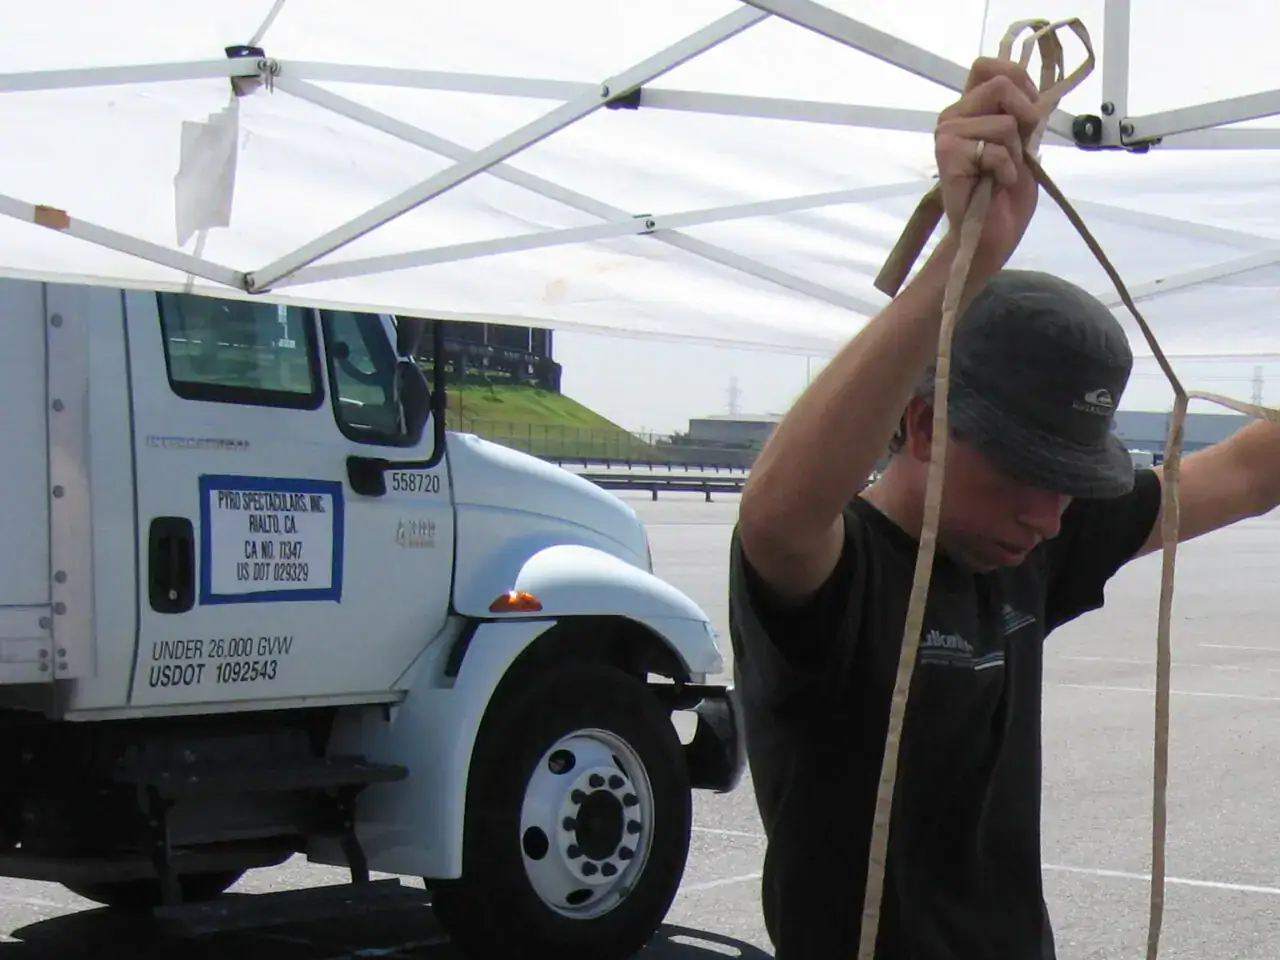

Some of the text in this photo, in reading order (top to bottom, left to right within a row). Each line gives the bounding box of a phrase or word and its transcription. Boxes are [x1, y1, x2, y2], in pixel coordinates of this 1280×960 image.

[392, 472, 440, 493] 558720
[218, 491, 240, 510] PYRO
[244, 541, 258, 559] CA
[279, 541, 302, 560] 11347
[236, 562, 309, 581] US DOT 029329
[152, 639, 204, 661] UNDER
[257, 635, 294, 656] GVW
[149, 659, 278, 688] USDOT 1092543
